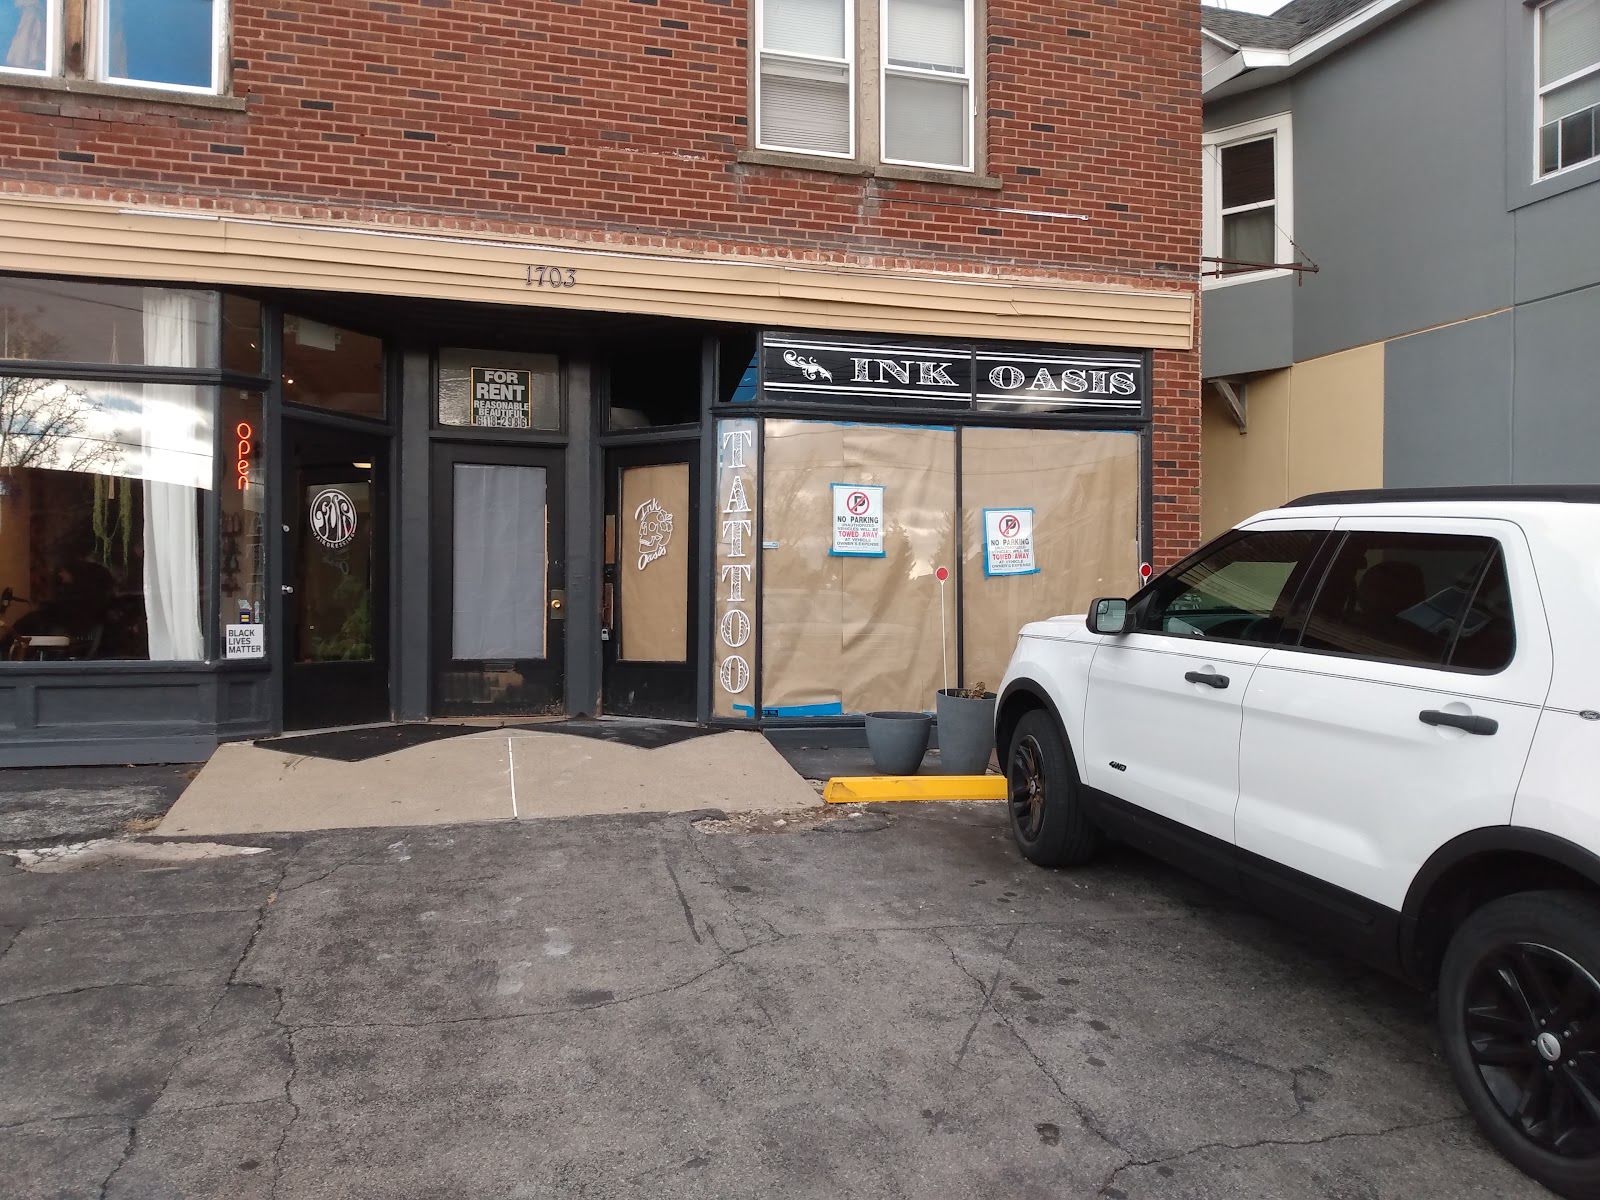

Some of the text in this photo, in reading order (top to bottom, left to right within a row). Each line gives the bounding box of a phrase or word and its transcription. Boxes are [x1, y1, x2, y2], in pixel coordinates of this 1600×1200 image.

[526, 265, 577, 288] 1703
[484, 370, 519, 384] FOR
[850, 357, 1137, 395] INK OASIS
[476, 383, 525, 401] RENT
[474, 400, 529, 411] REASONABLE
[478, 408, 525, 418] BEAUTIFUL
[634, 498, 661, 521] Ink
[850, 516, 879, 524] PARKING
[312, 530, 356, 549] HAIRDRESSING
[1003, 538, 1030, 546] PARKING
[637, 546, 666, 570] Oasis
[720, 430, 752, 694] TATTOO
[228, 629, 255, 637] BLACK
[228, 637, 251, 645] LIVES
[228, 645, 262, 654] MATTER
